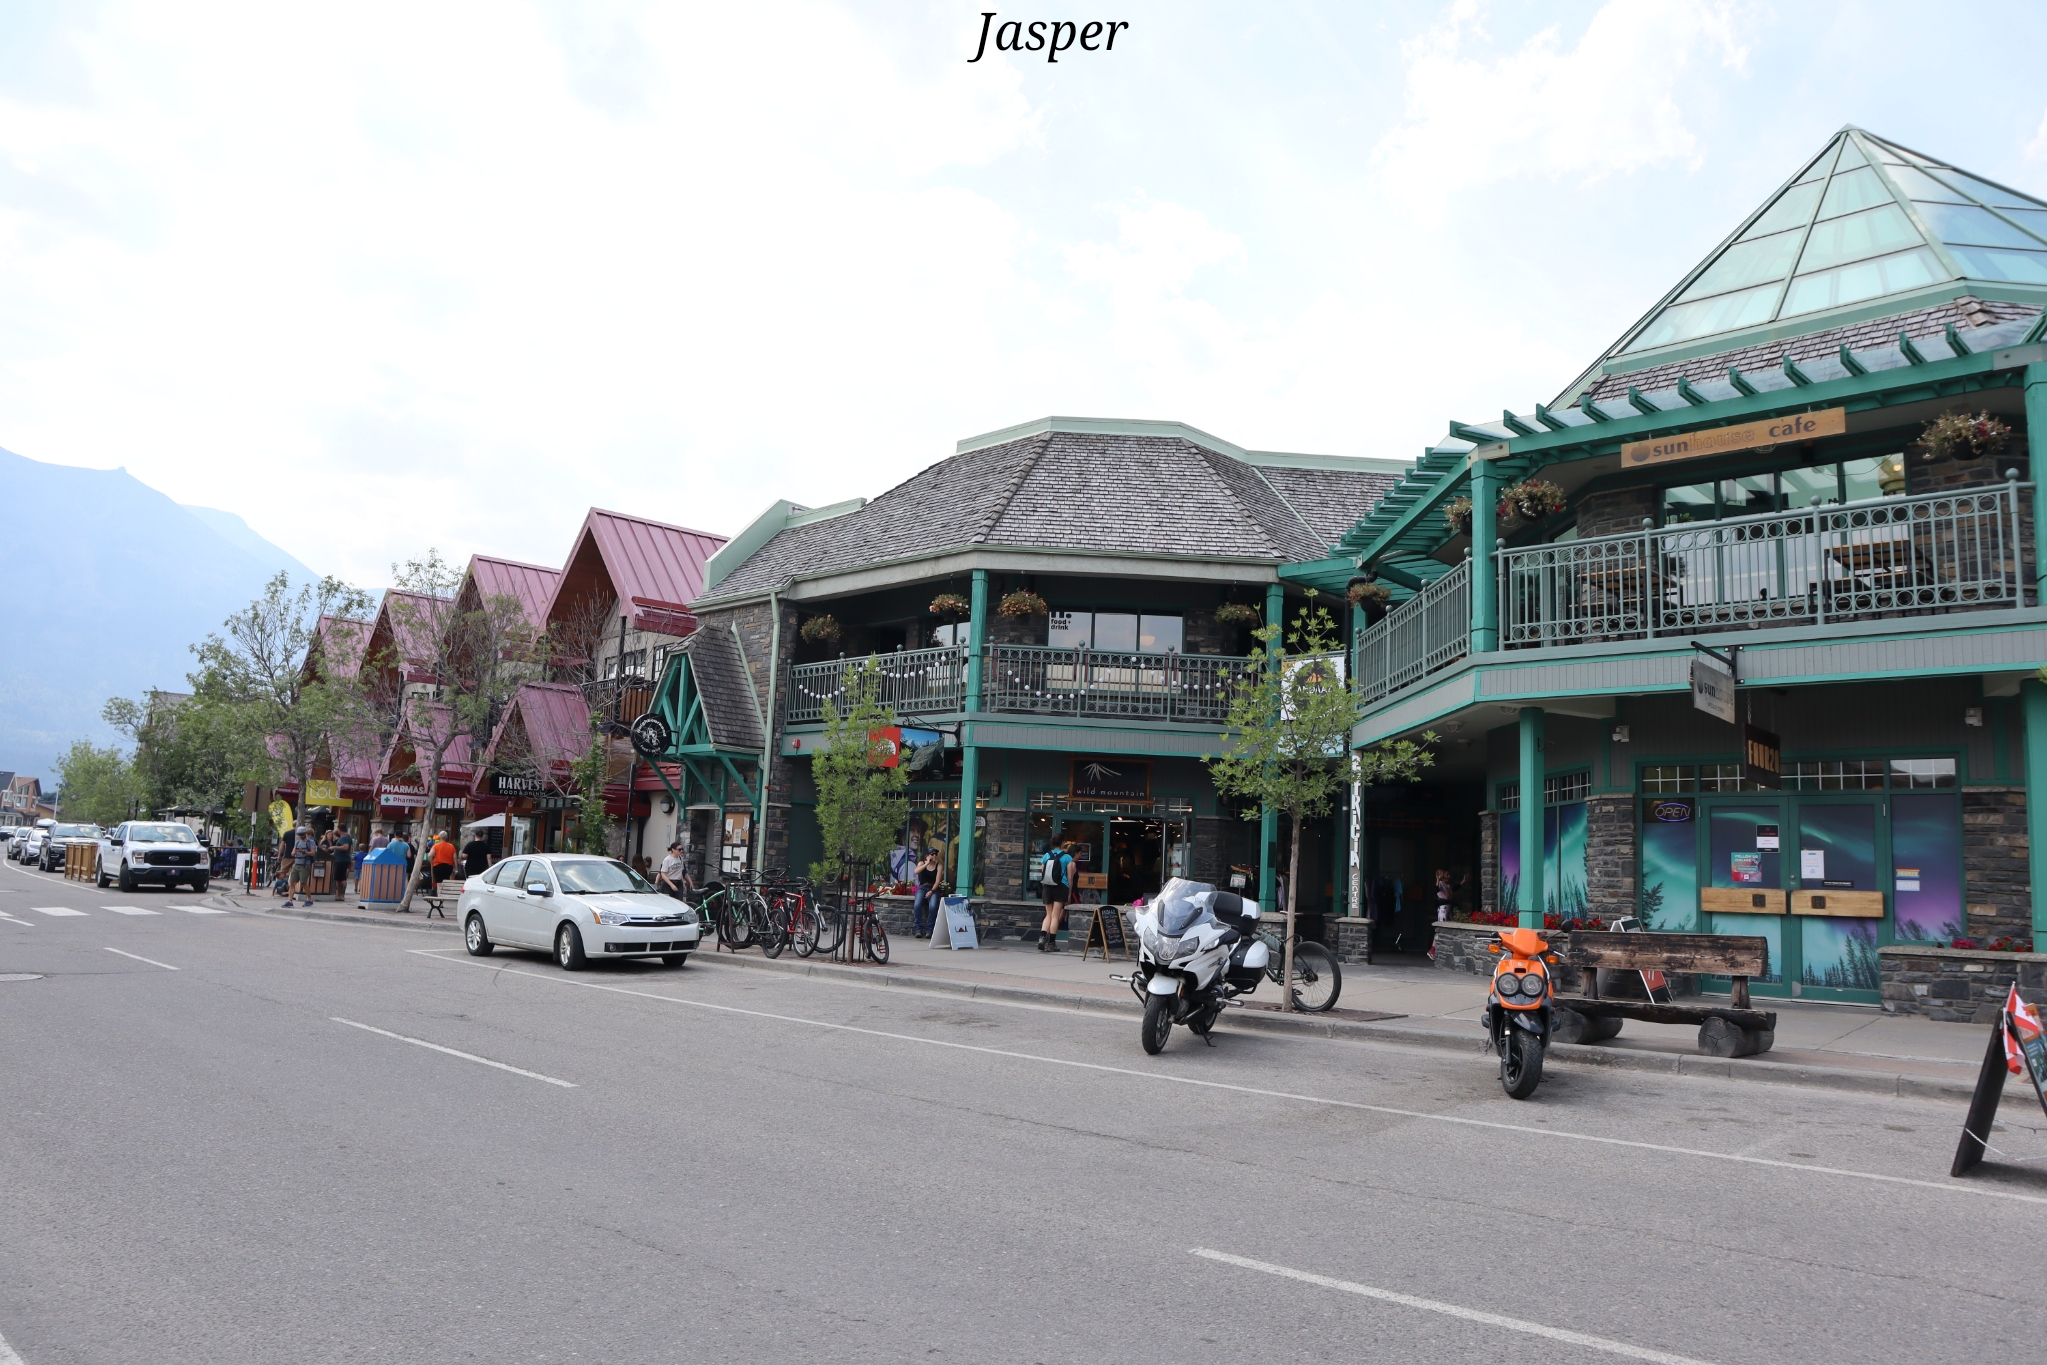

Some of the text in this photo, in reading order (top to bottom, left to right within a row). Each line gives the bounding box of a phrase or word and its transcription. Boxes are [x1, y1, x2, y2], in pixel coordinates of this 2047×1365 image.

[1652, 416, 1817, 457] sunhouse cafe
[498, 776, 546, 791] HARVEST
[1076, 786, 1145, 797] wild mountain
[393, 796, 427, 805] Pharmacy
[1655, 807, 1691, 818] OPEN
